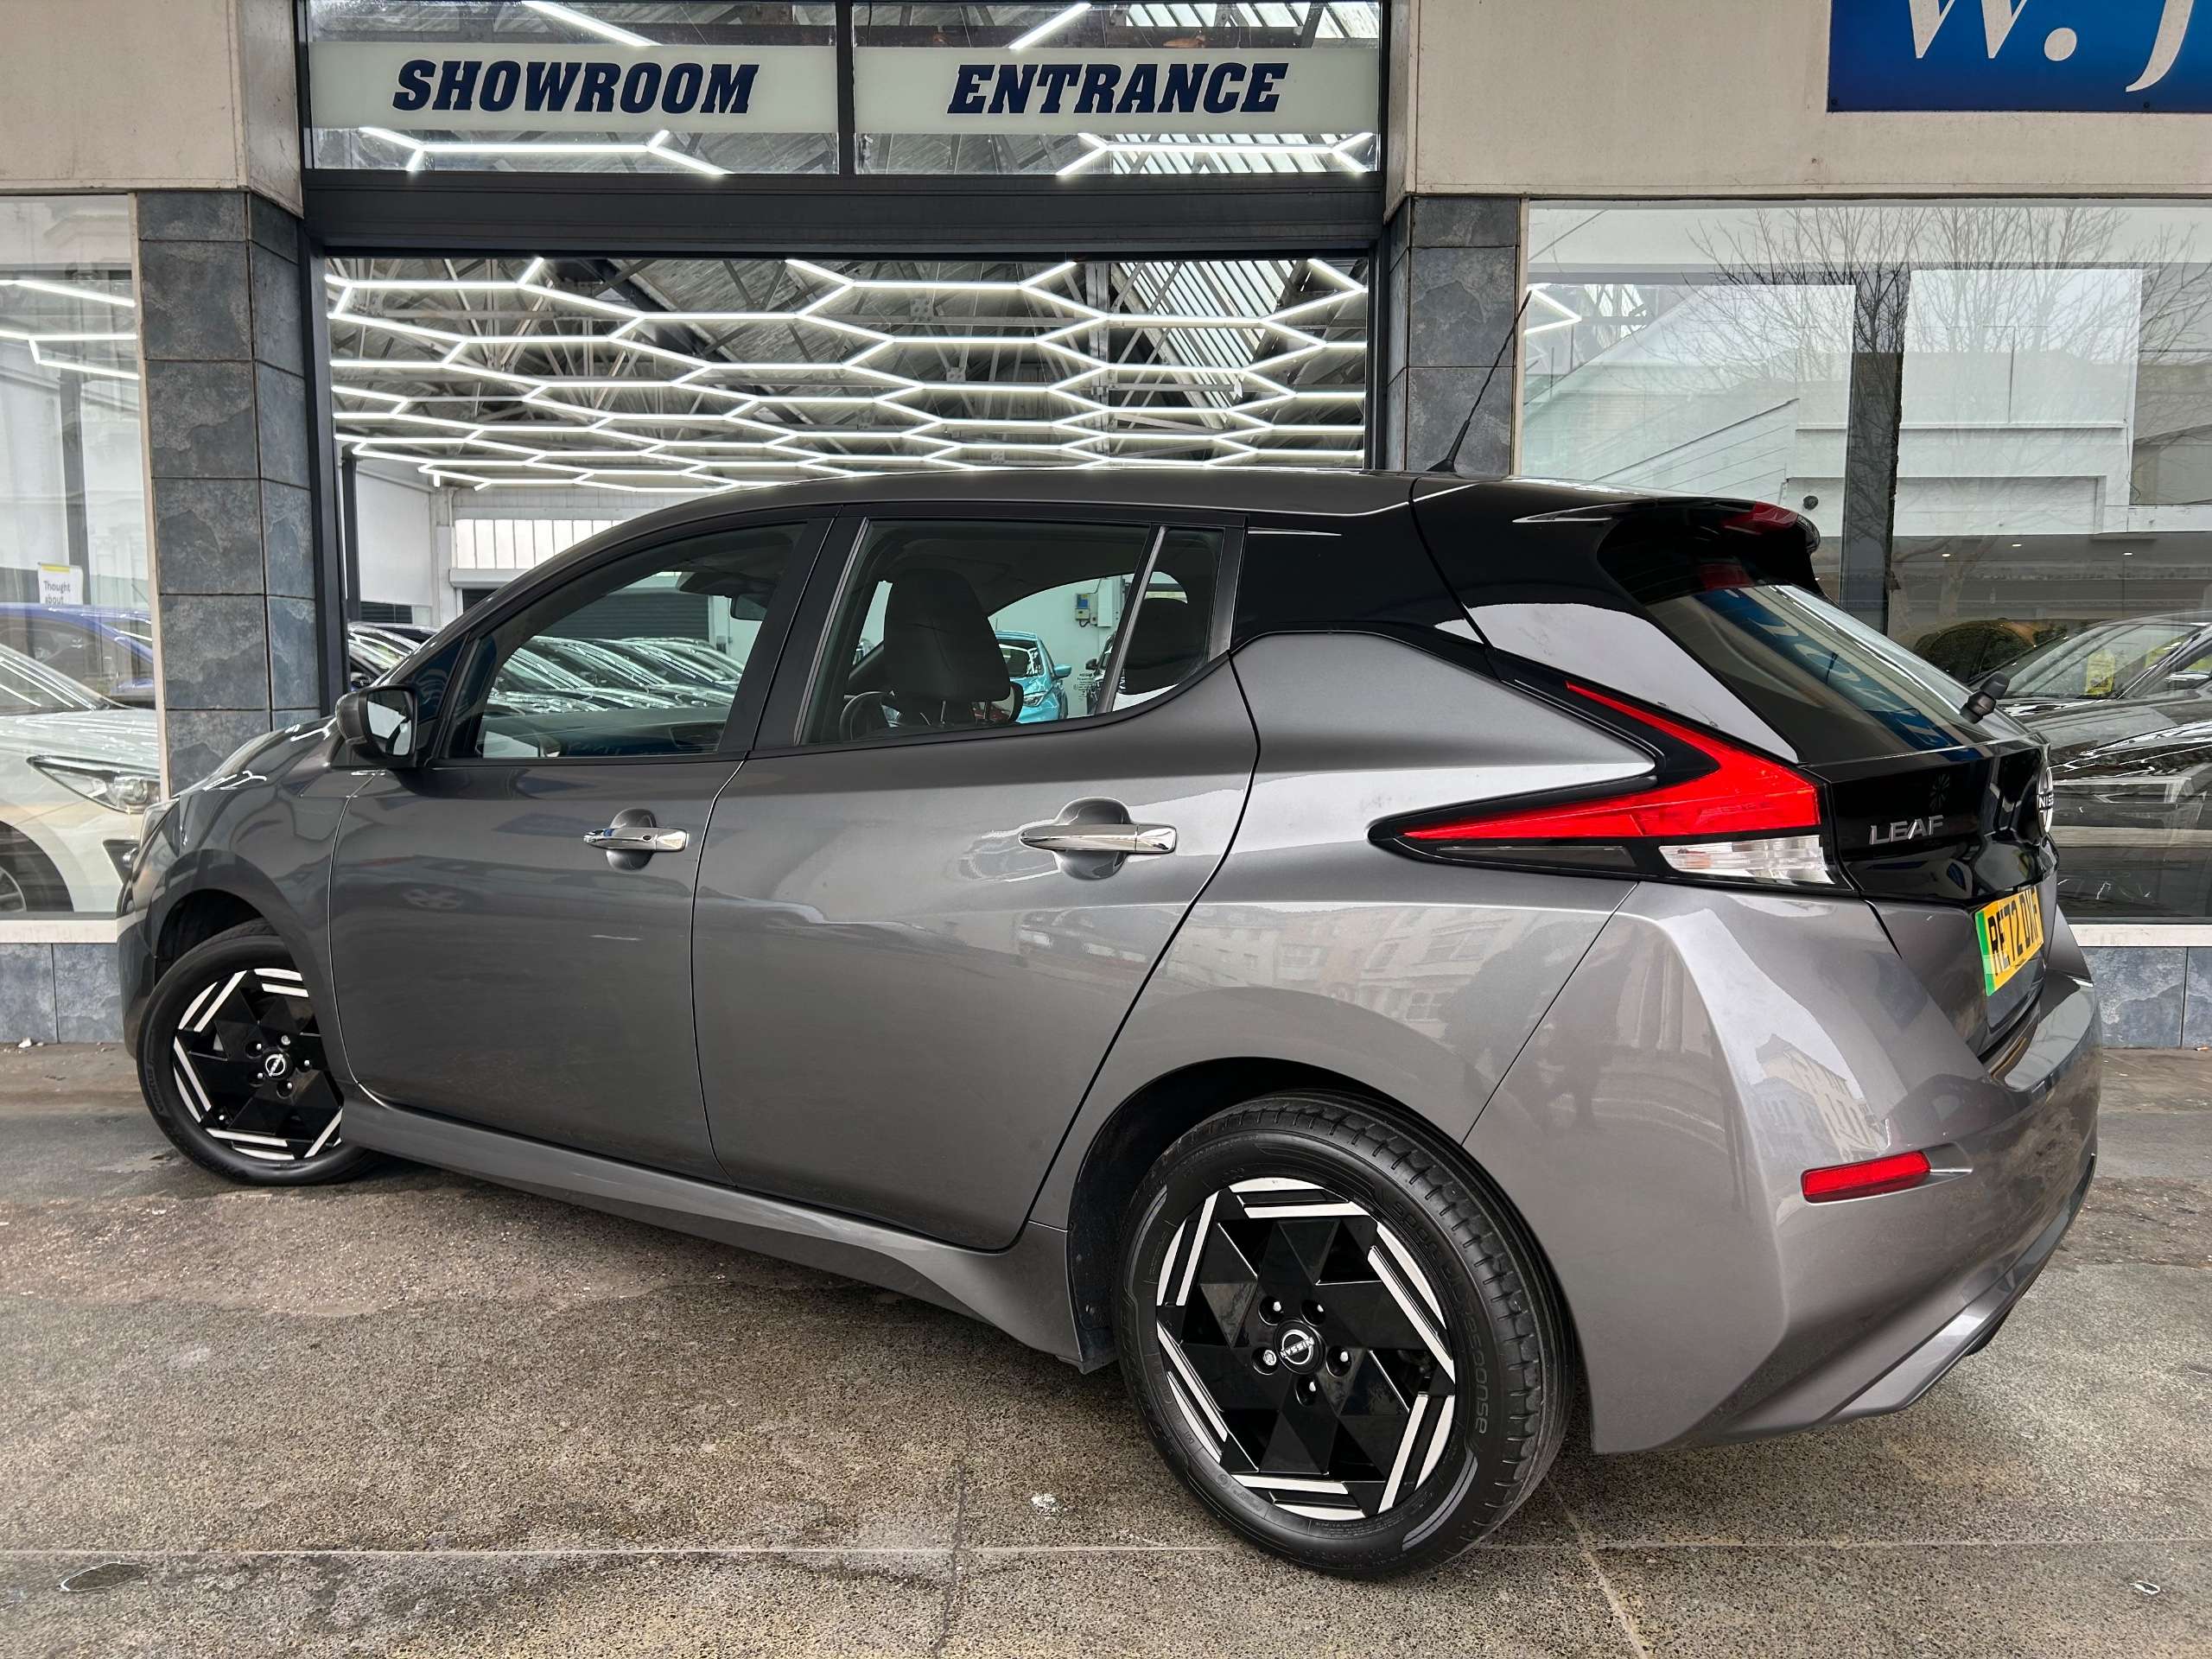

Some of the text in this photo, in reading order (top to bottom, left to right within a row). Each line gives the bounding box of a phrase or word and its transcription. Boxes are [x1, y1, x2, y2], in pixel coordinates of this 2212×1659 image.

[392, 60, 1289, 114] SHOWROOM ENTRANCE
[43, 580, 71, 594] Thought
[1868, 814, 1944, 845] LEAF
[1280, 1337, 1315, 1358] NISSAN
